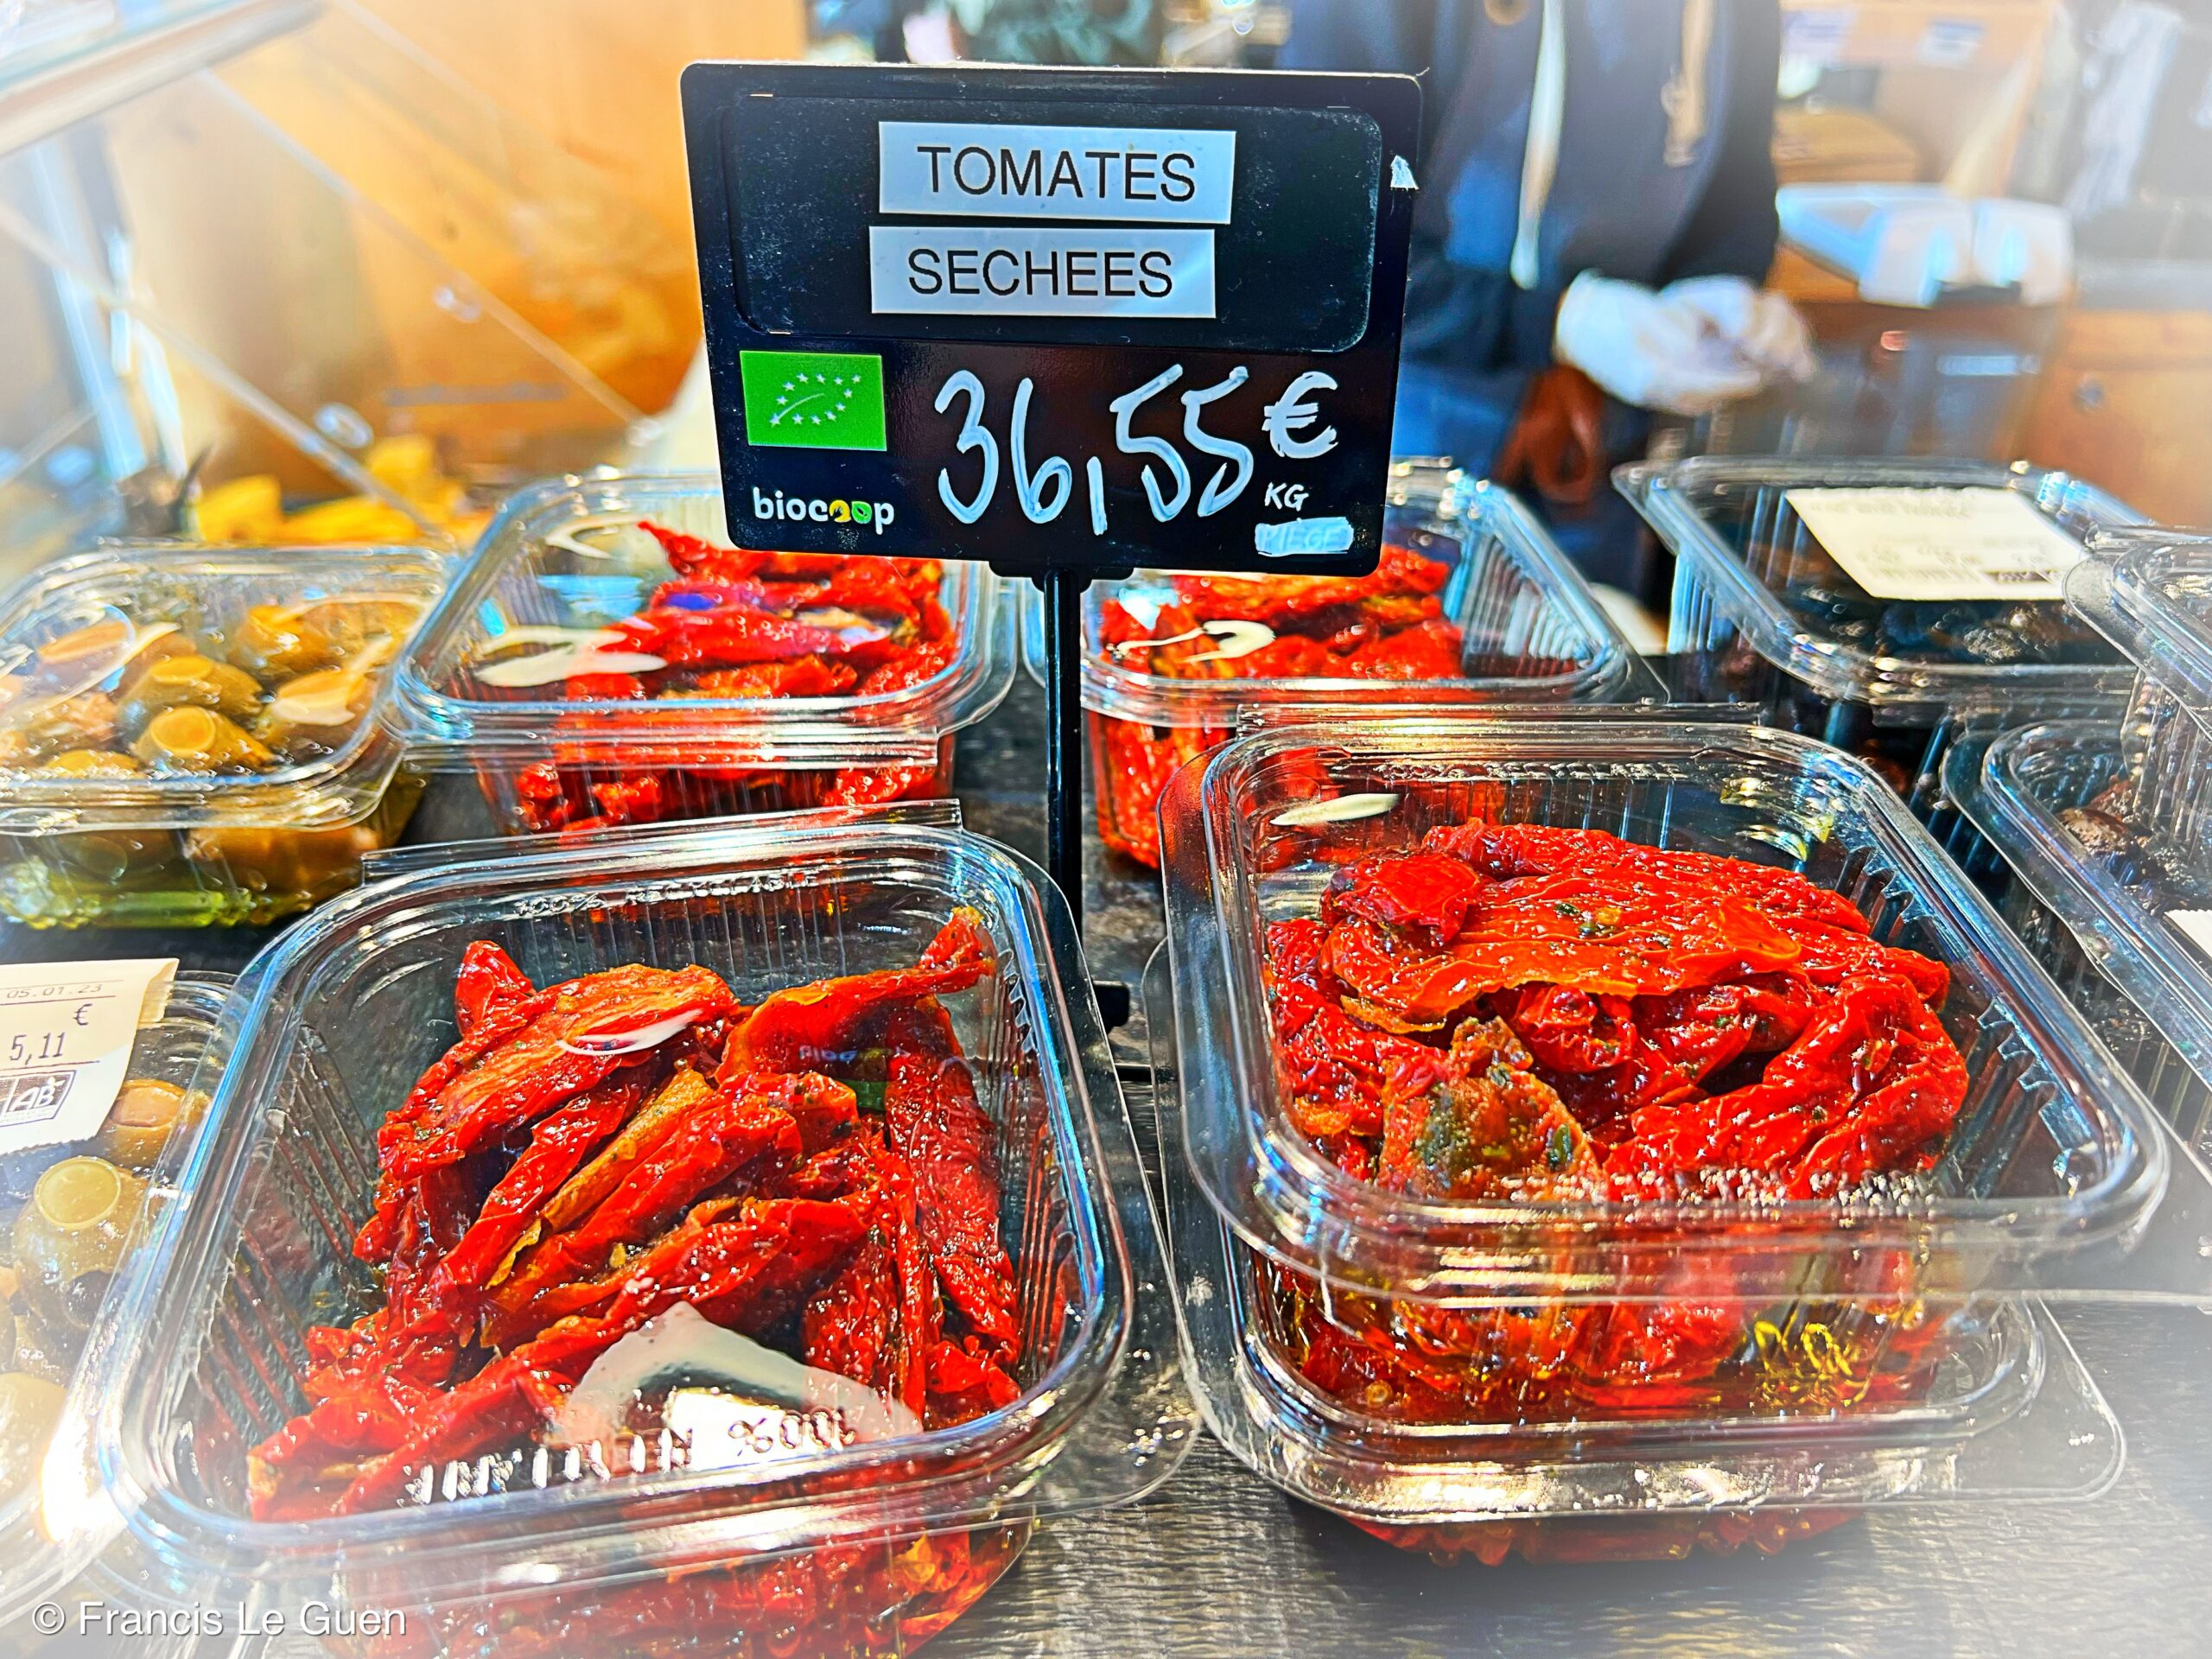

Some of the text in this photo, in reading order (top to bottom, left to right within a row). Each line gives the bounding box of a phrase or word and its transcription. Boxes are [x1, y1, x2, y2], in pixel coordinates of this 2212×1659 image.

[917, 145, 1196, 202] TOMATES
[907, 247, 1173, 298] SECHEES
[934, 364, 1338, 536] 36,55 €
[753, 486, 895, 535] biocoop
[1264, 482, 1310, 512] KG
[7, 983, 103, 999] 05.01.23
[73, 1003, 93, 1026] €
[10, 1032, 66, 1065] 5,11
